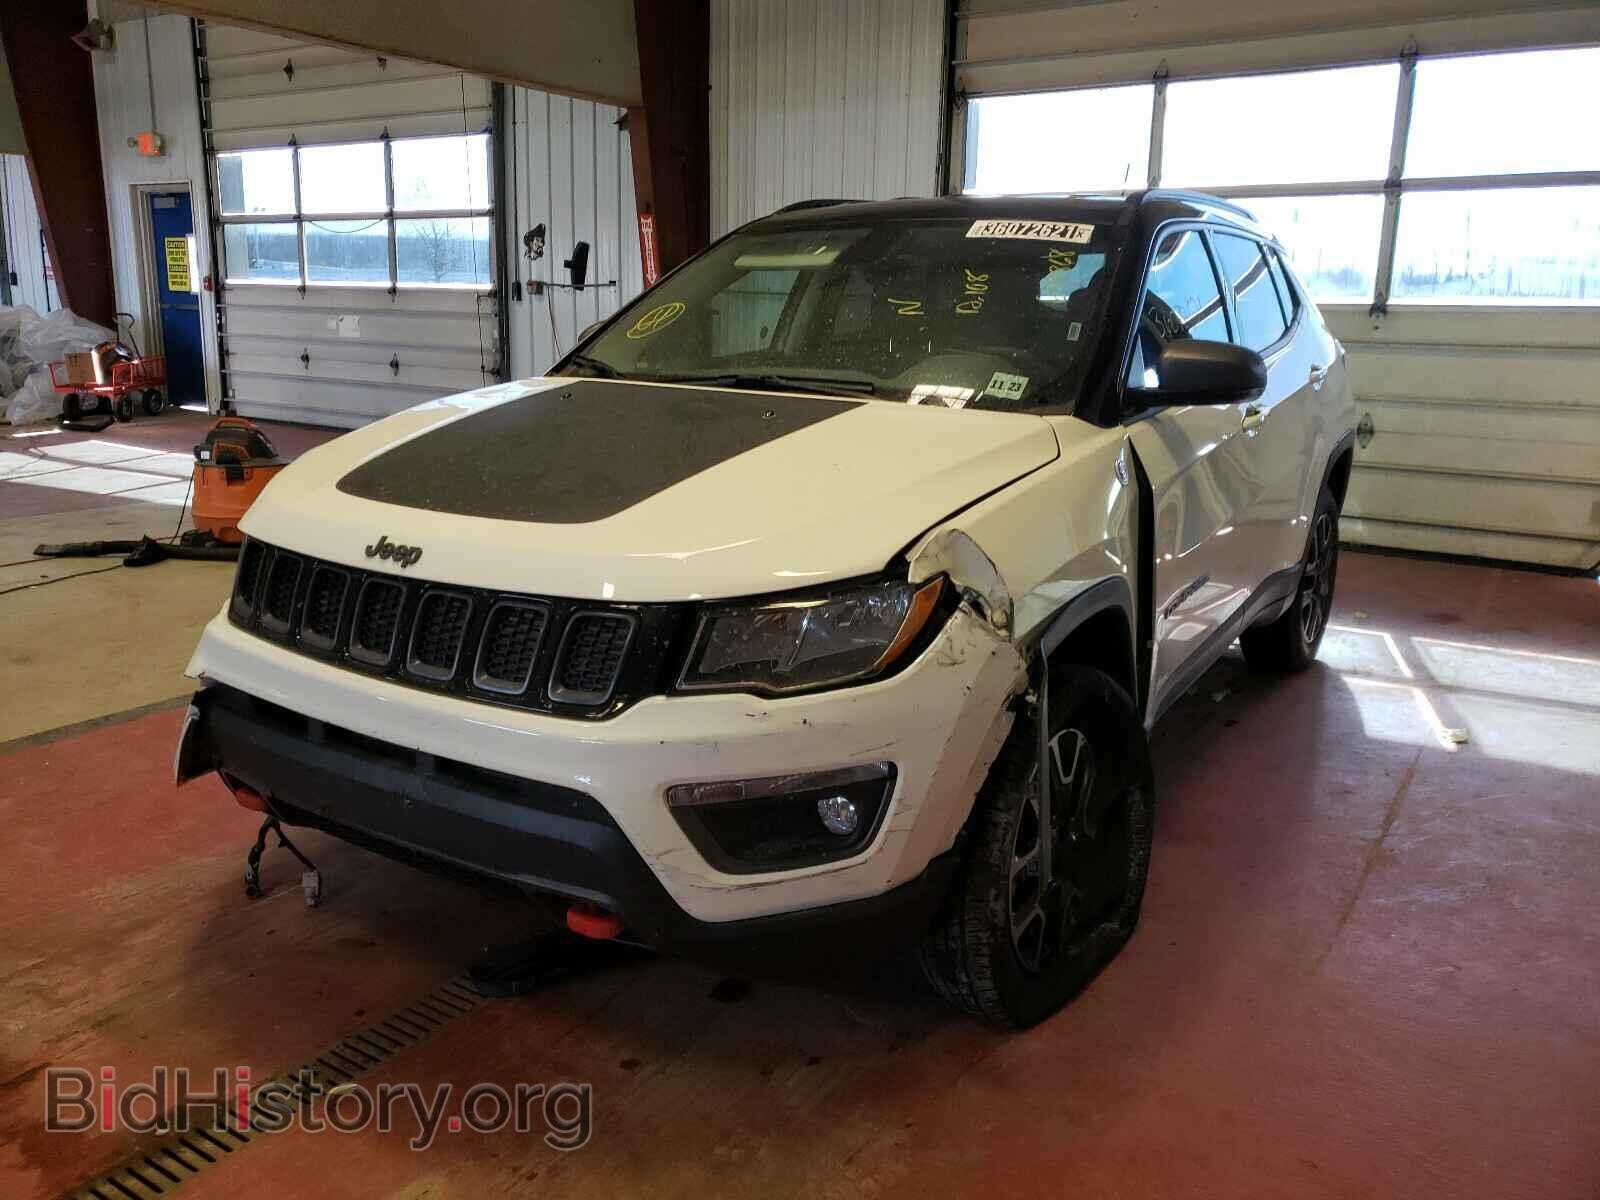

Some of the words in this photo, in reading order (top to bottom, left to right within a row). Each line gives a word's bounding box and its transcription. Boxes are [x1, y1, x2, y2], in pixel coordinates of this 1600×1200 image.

[981, 221, 1078, 239] 36072621
[991, 379, 1005, 390] 11
[1008, 382, 1022, 392] 23
[365, 535, 422, 569] Jeep
